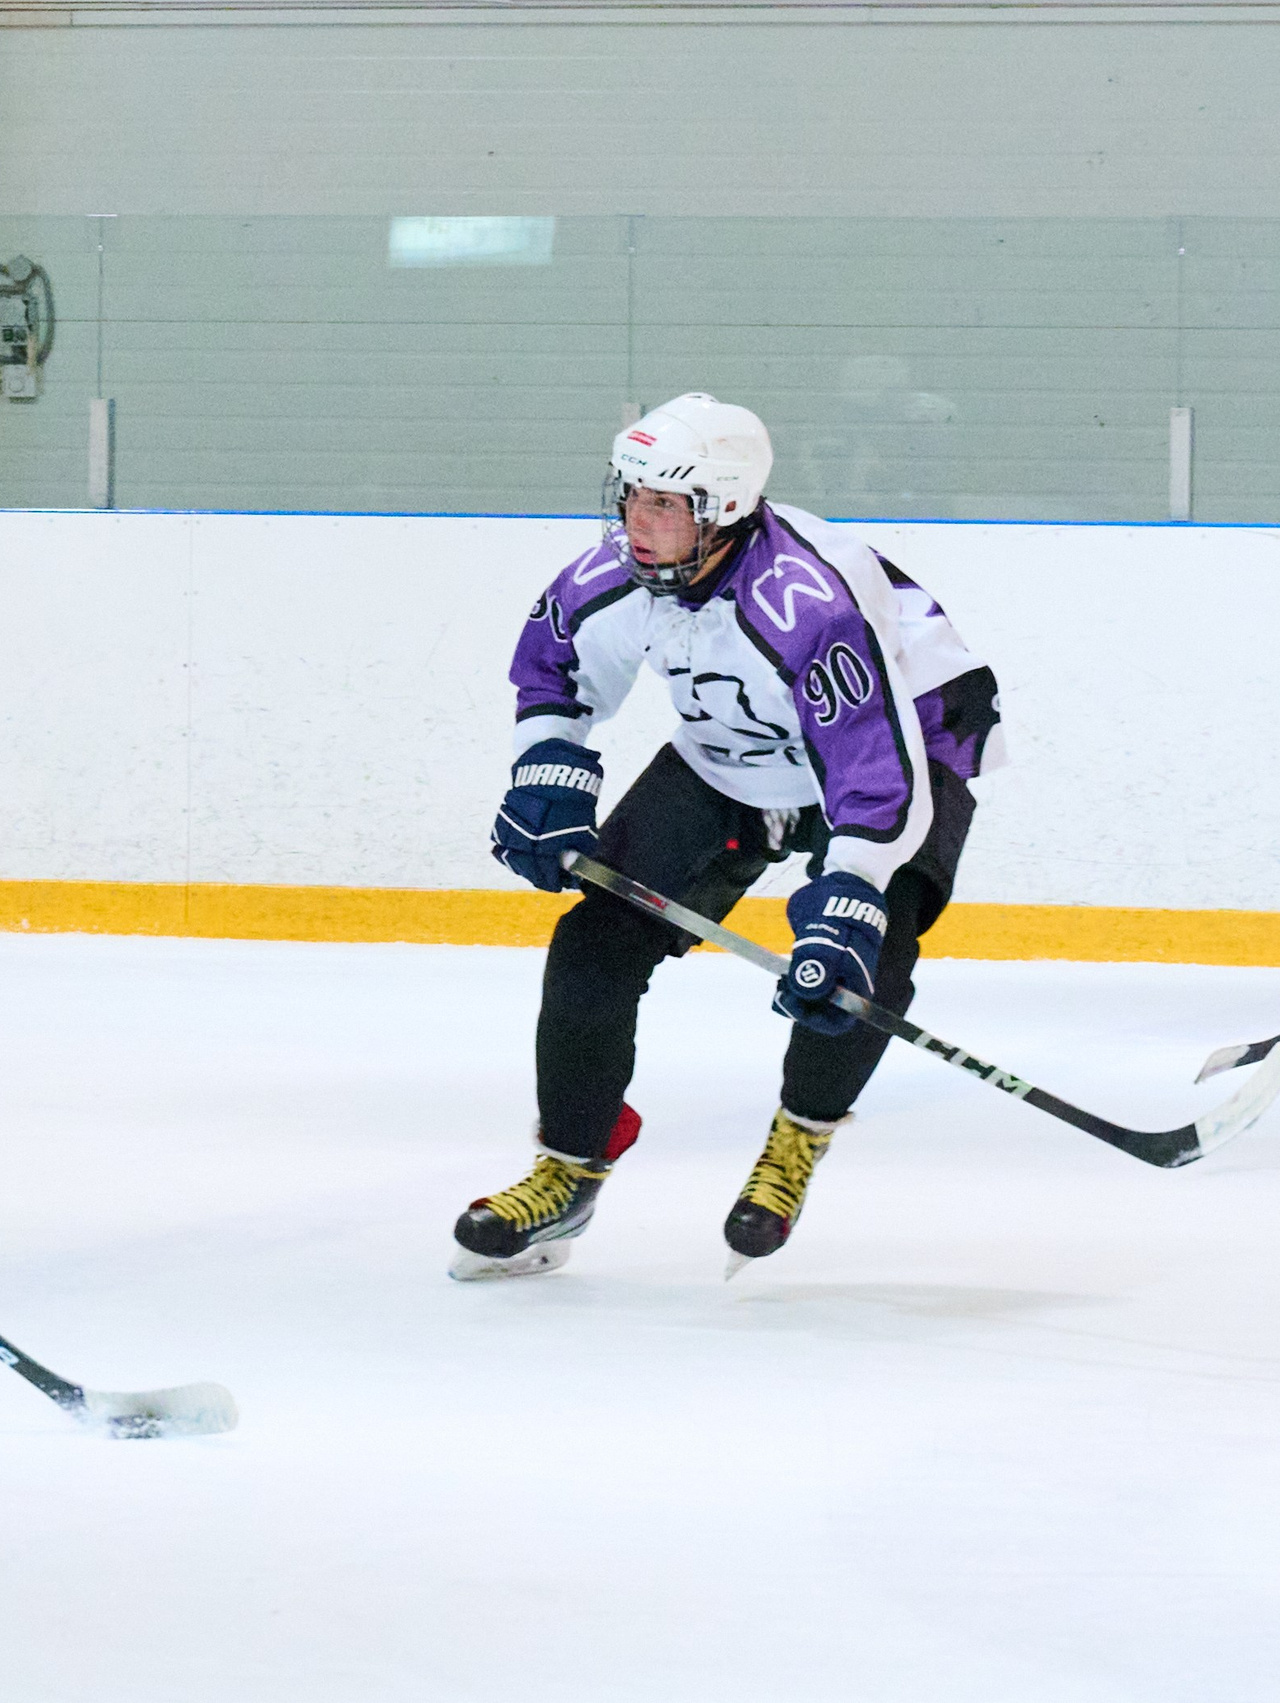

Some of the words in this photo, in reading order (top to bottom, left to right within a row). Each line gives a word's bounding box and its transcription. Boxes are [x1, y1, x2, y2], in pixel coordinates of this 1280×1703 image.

[621, 453, 648, 466] CCM
[802, 641, 874, 727] 90
[912, 1028, 1034, 1101] CCM
